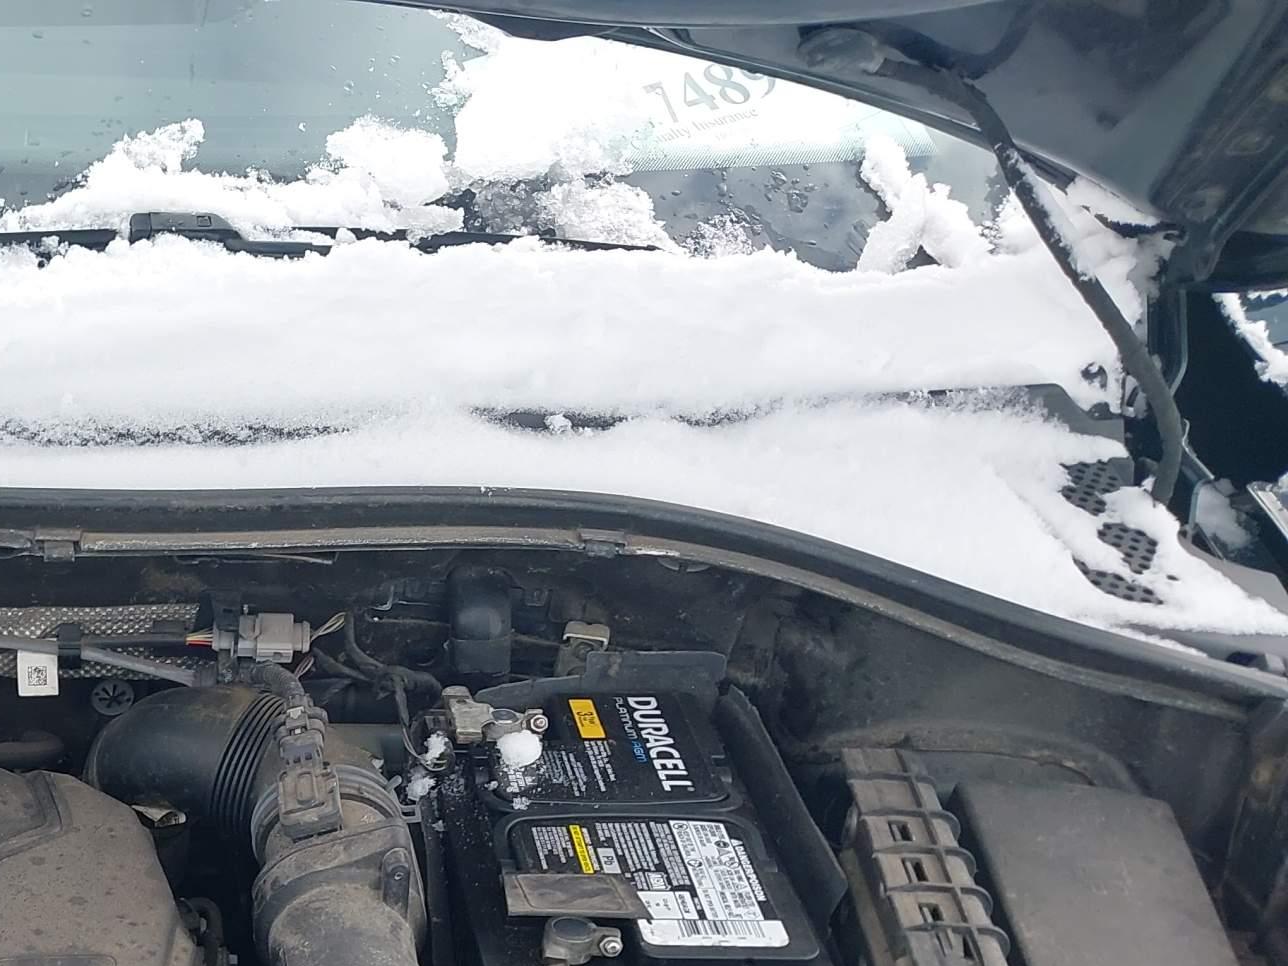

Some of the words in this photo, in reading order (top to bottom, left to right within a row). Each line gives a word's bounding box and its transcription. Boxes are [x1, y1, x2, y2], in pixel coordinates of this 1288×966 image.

[690, 109, 759, 132] Insurance
[614, 697, 638, 741] PLATINUM
[632, 740, 648, 764] AGM
[627, 696, 690, 792] DURACELL
[602, 855, 616, 870] Pb
